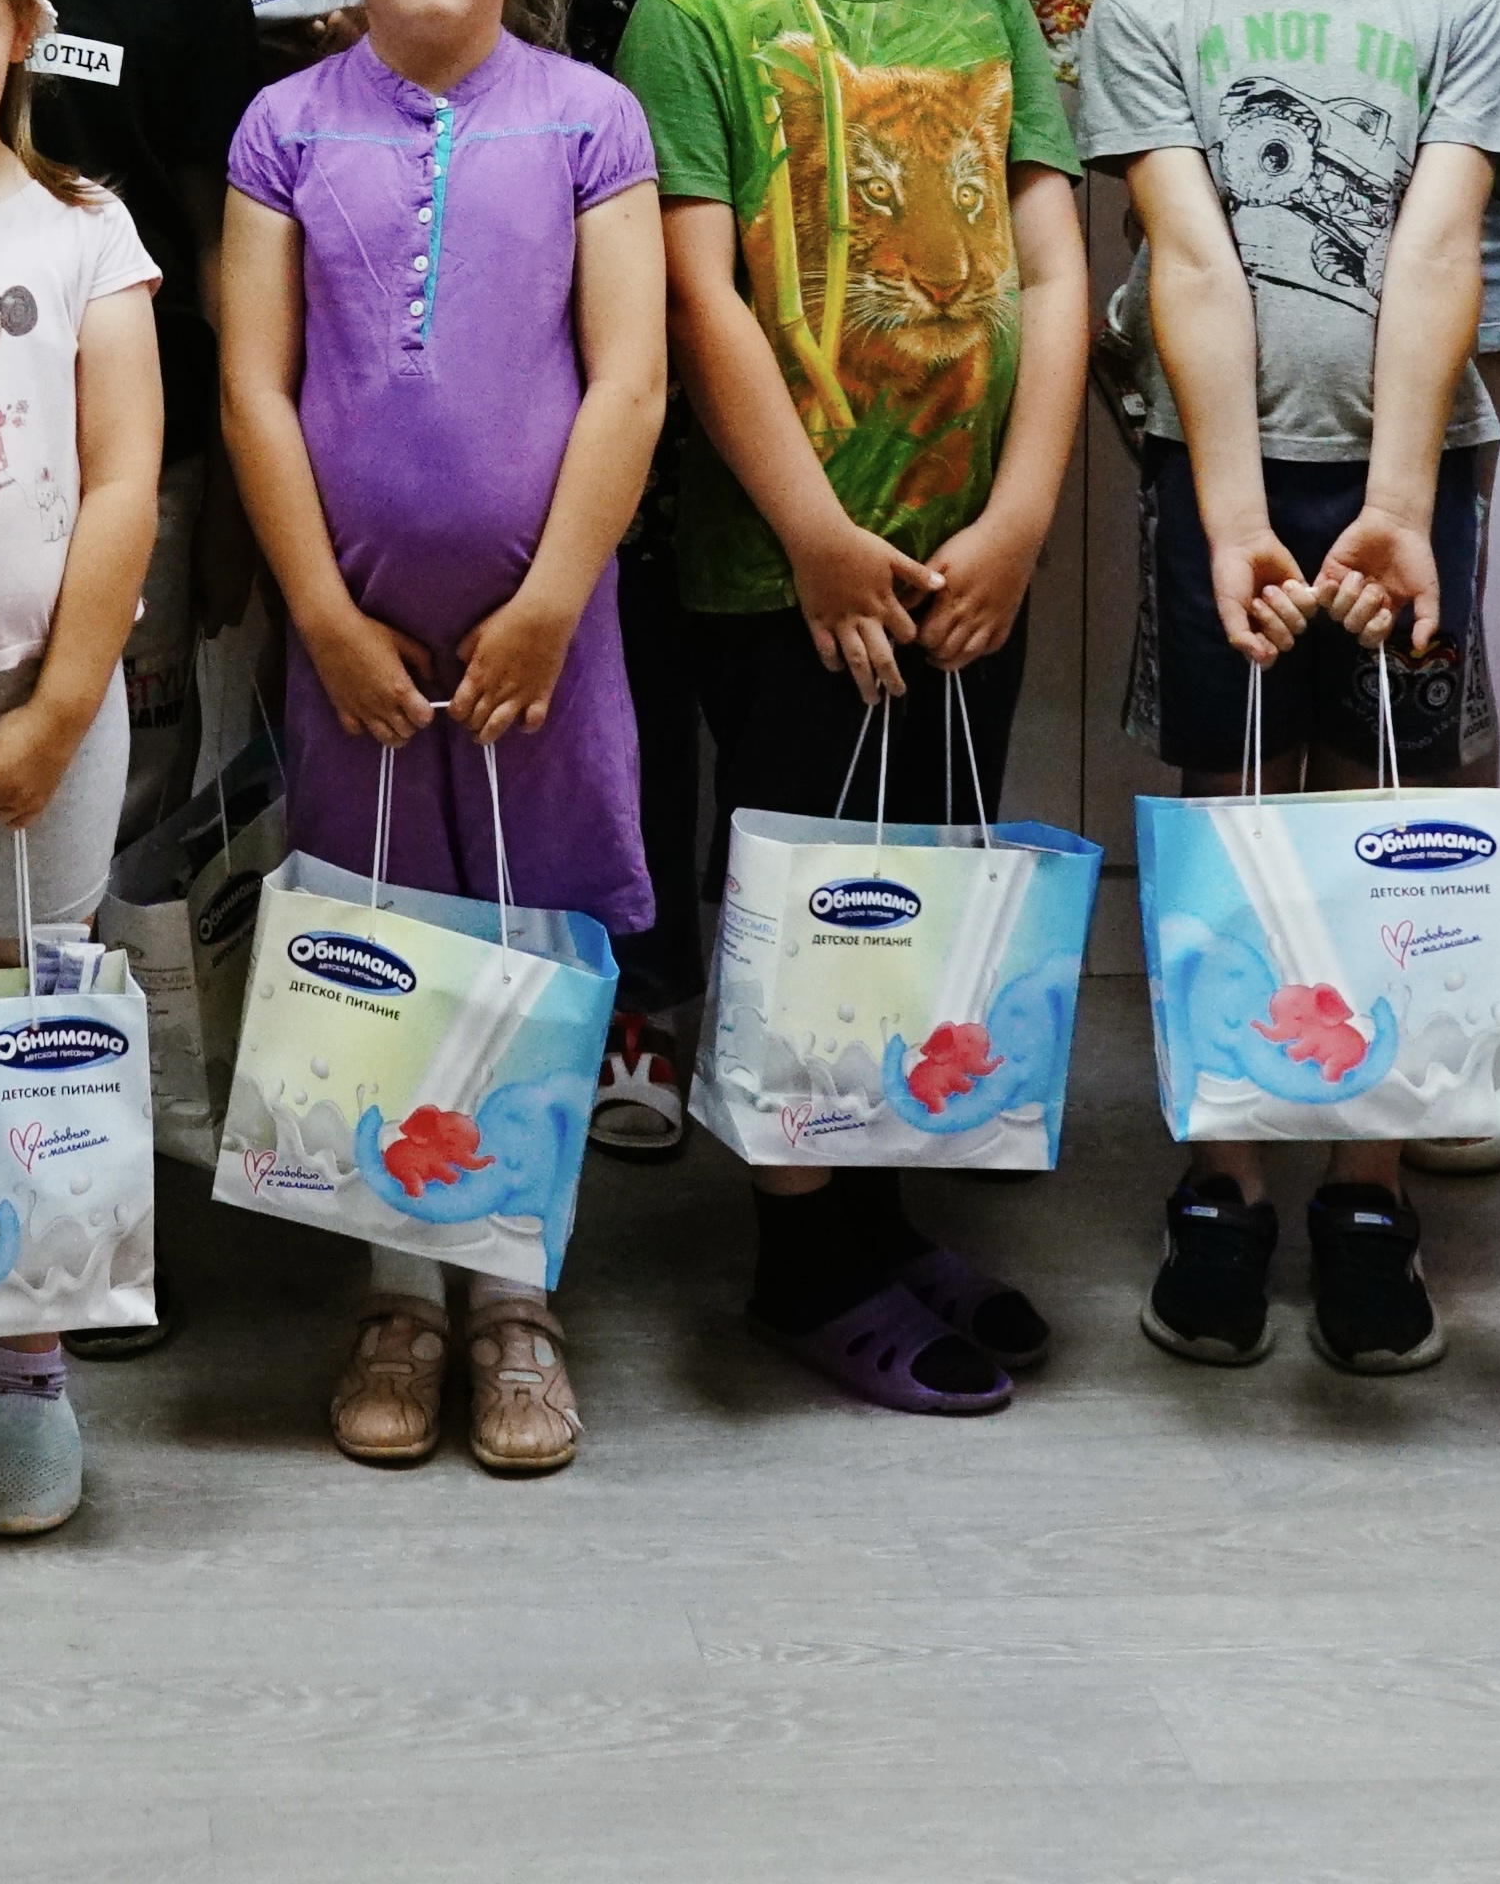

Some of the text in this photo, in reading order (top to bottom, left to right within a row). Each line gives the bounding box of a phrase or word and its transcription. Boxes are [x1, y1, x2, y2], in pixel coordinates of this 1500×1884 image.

[1244, 10, 1332, 65] NOT
[44, 43, 110, 72] ОТЦА
[1357, 827, 1493, 861] Обнимама
[812, 886, 918, 917] Обнимама
[1370, 882, 1493, 899] ДЕТСКОЕ ПИТАНИЕ
[812, 933, 913, 948] ДЕТСКОЕ ПИТАНИЕ
[290, 936, 413, 991] Обнимама
[288, 978, 401, 1022] ДЕТСКОЕ ПИТАНИЕ
[1, 1081, 122, 1101] ДЕТСКОЕ ПИТАНИЕ
